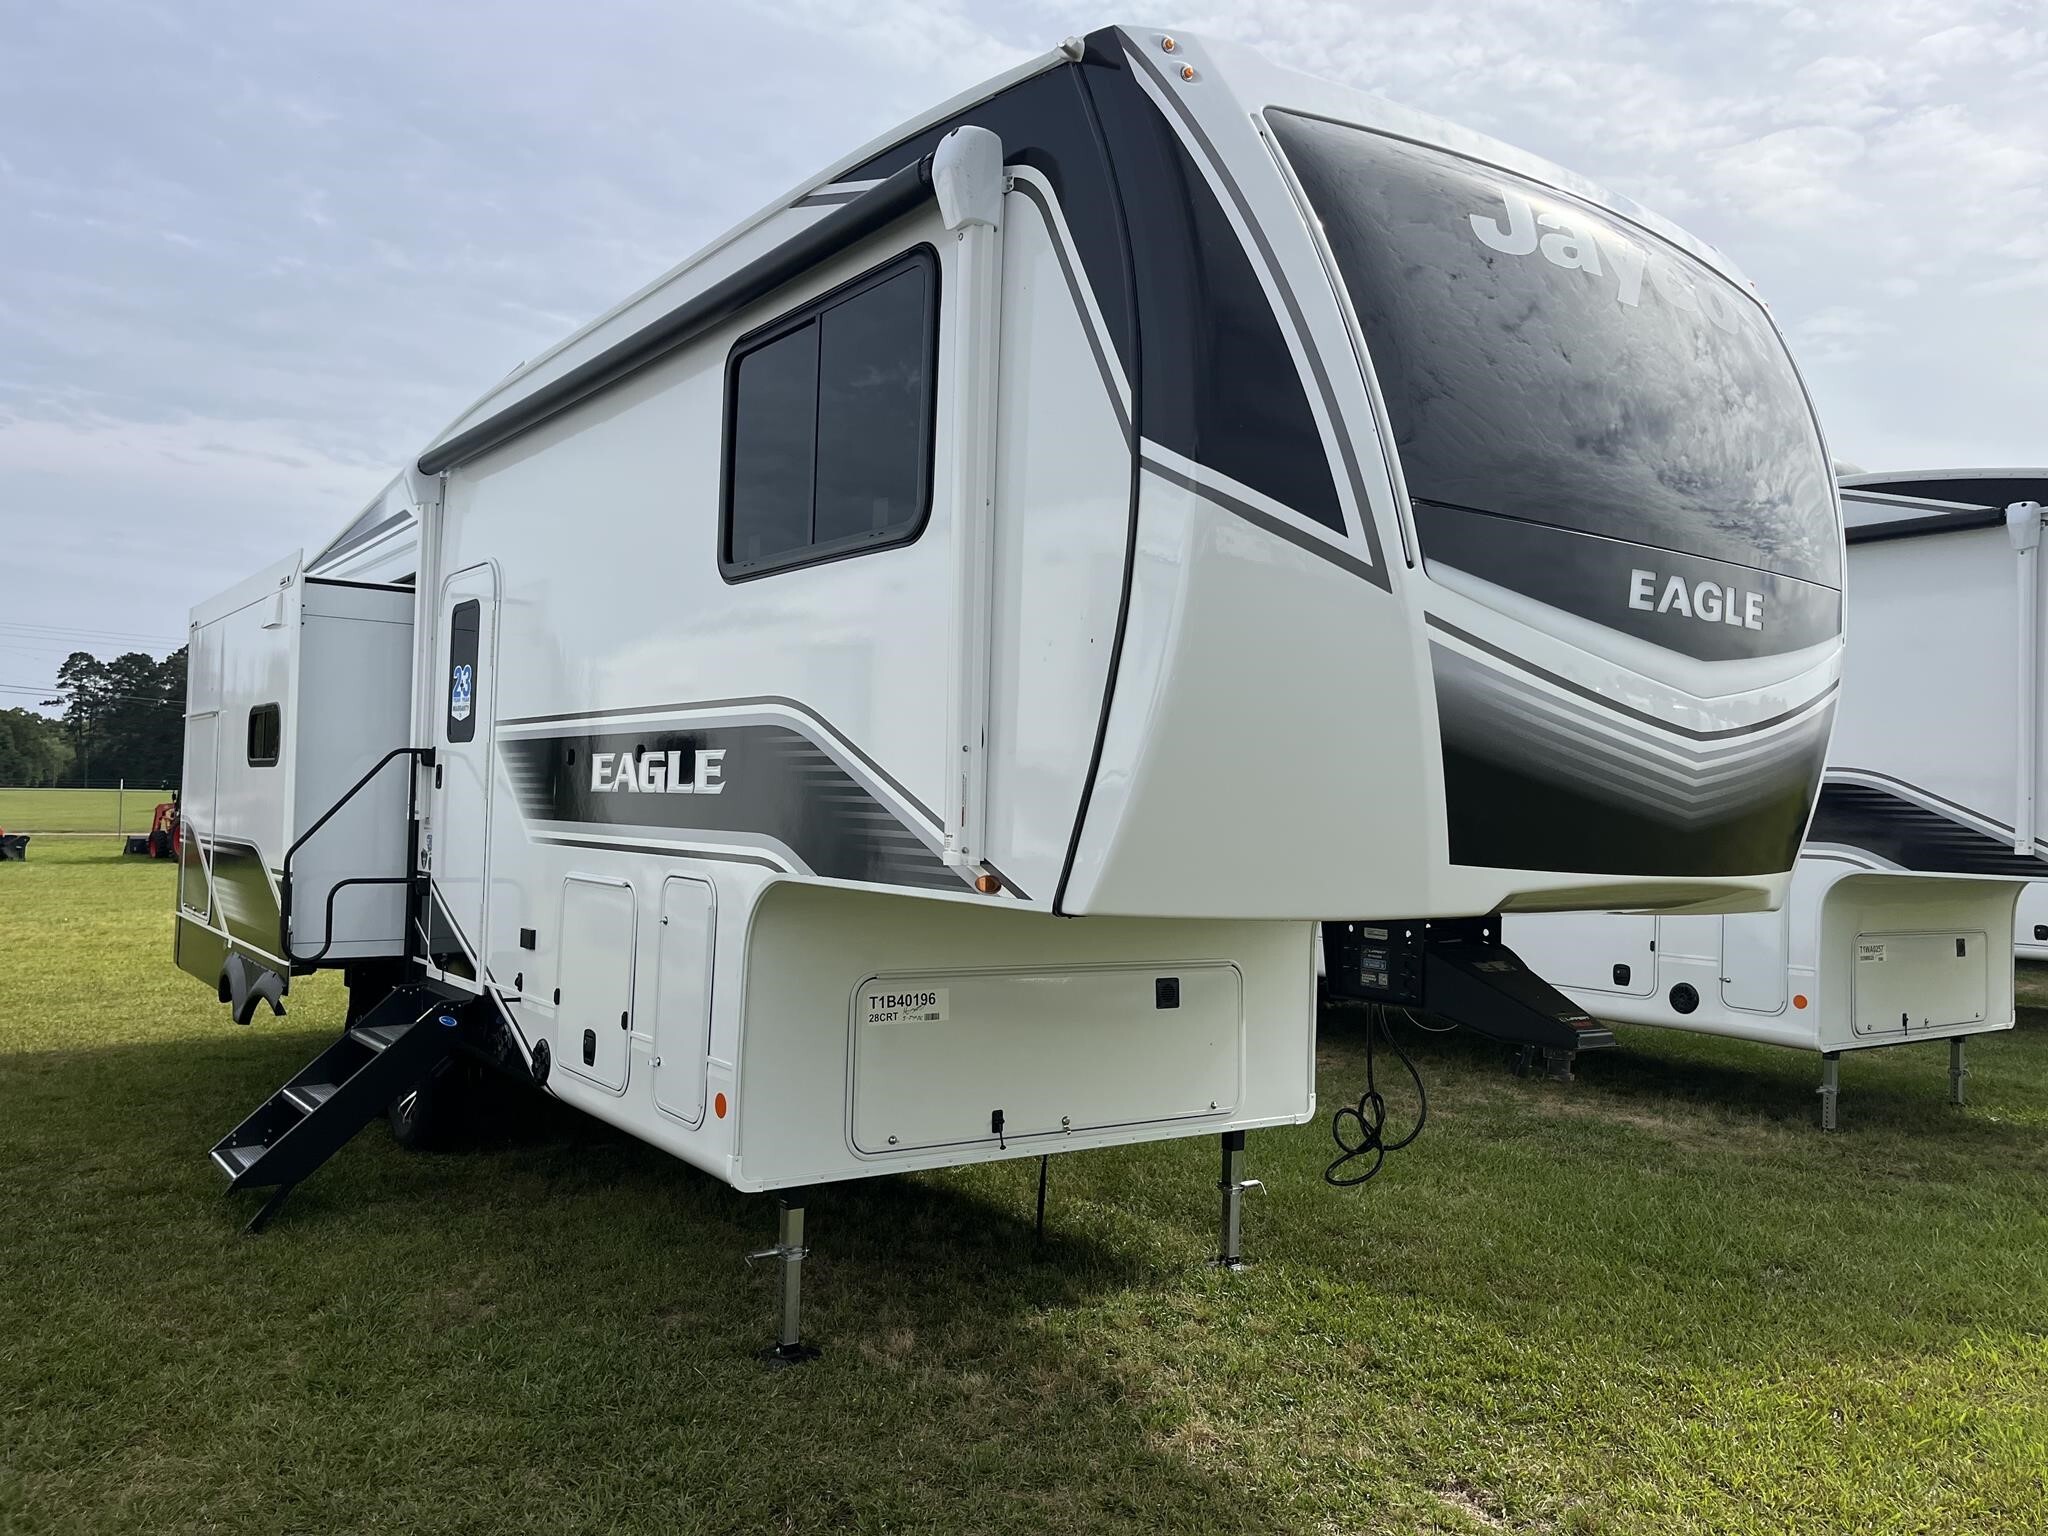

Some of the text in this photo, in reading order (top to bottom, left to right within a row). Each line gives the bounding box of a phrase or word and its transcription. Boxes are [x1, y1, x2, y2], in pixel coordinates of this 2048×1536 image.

[1628, 568, 1765, 632] EAGLE
[591, 749, 727, 795] EAGLE
[869, 992, 936, 1009] T1B40196
[869, 1012, 898, 1023] 28CRT
